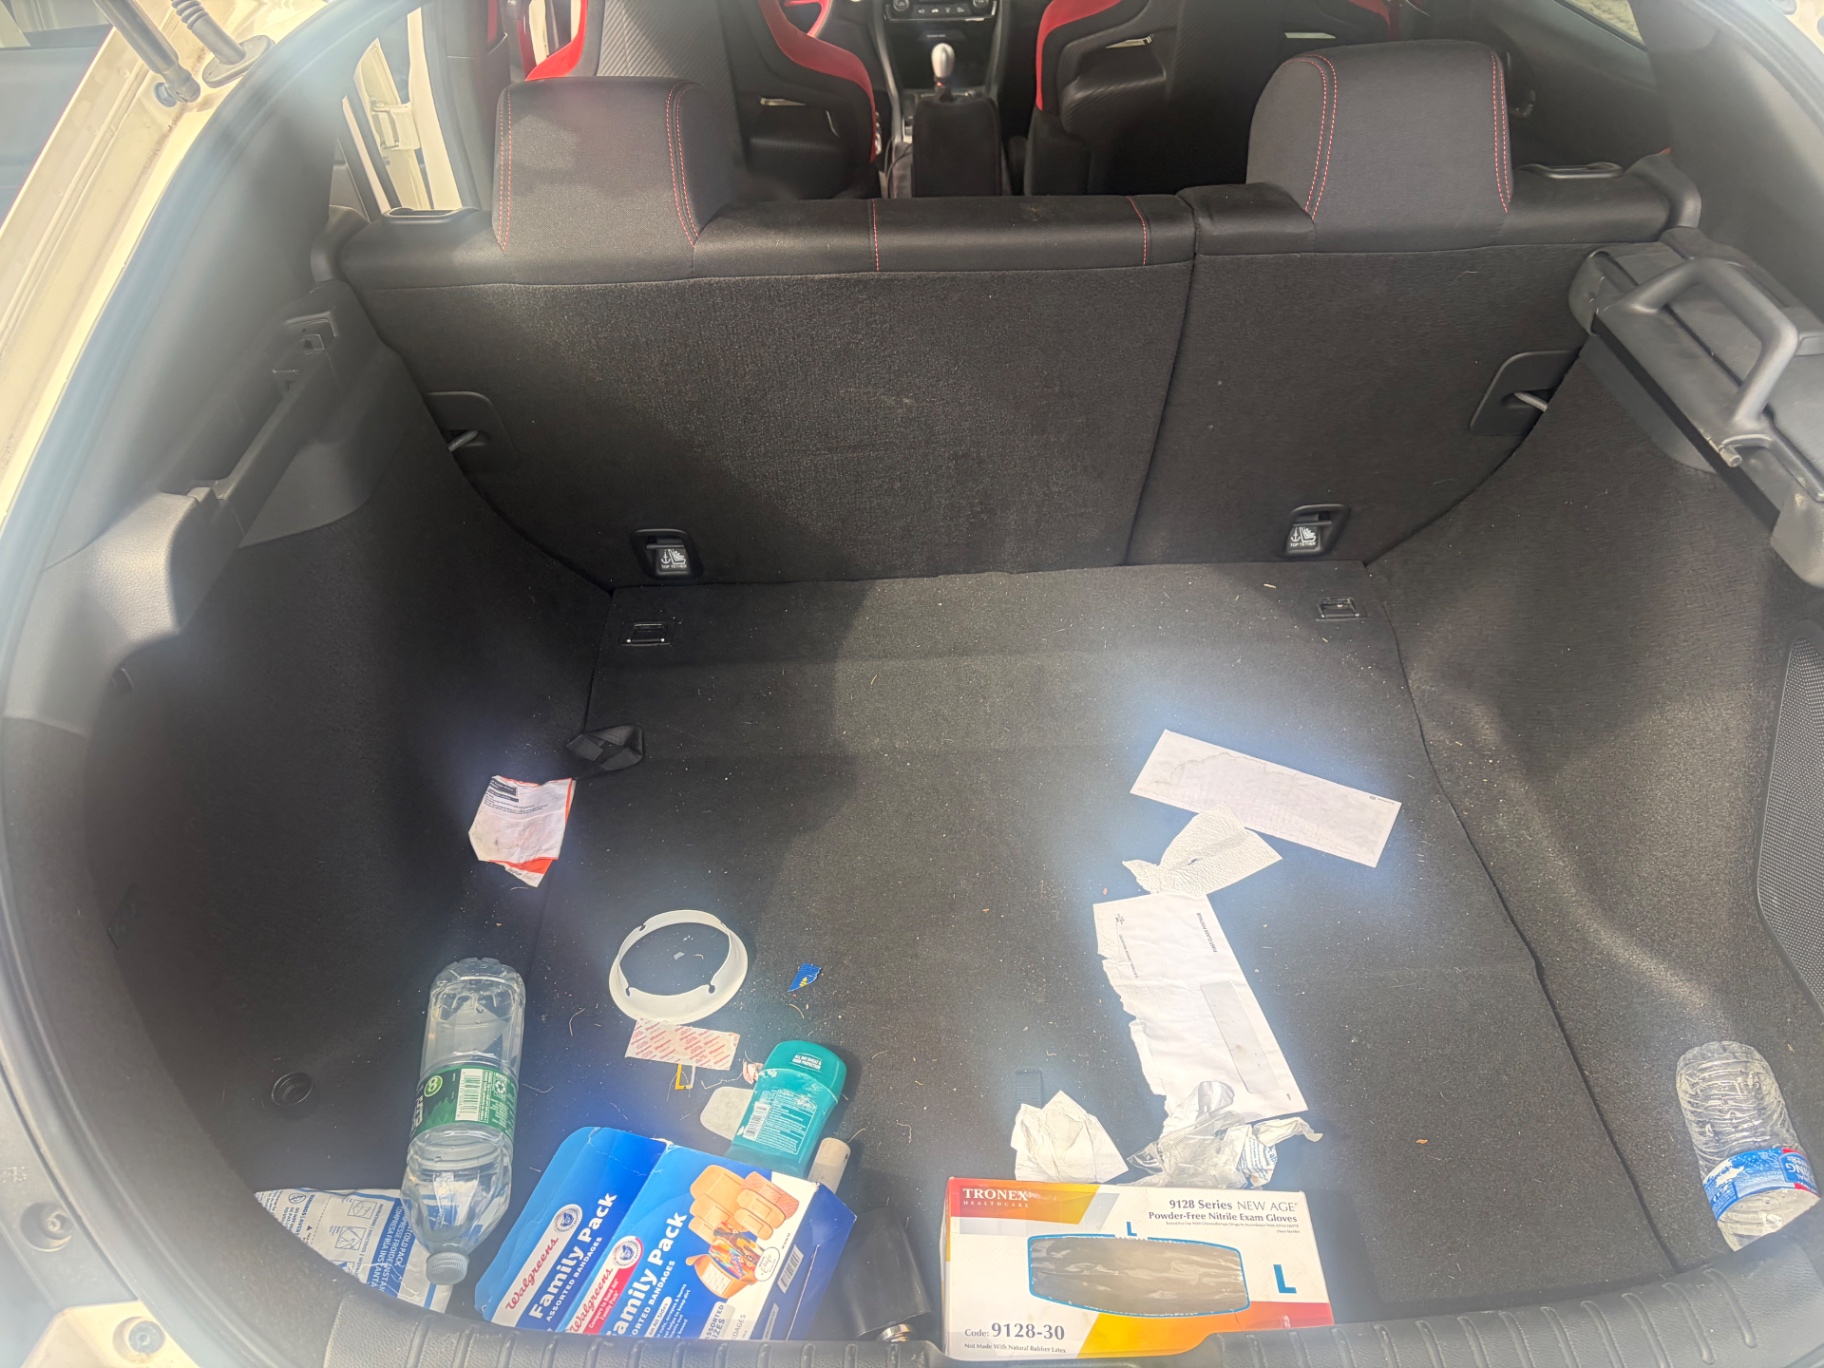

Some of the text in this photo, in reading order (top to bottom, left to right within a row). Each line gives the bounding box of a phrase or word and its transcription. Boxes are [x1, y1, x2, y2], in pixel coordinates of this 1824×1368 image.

[962, 1188, 1029, 1202] TRONEX
[1169, 1200, 1195, 1209] 9128
[1198, 1200, 1233, 1210] Series
[1237, 1200, 1265, 1211] NEW
[386, 1206, 402, 1235] COMPRESA
[1126, 1222, 1137, 1237] L
[1148, 1212, 1297, 1223] Powder-Free Nitrile Exam Gloves
[387, 1240, 400, 1263] FROIDE
[401, 1232, 412, 1249] COLD
[647, 1212, 687, 1266] Pack
[395, 1248, 406, 1267] PACK
[529, 1246, 585, 1318] Family
[577, 1192, 617, 1242] Pack
[505, 1238, 559, 1310] Walgreens
[546, 1237, 602, 1322] ASSORTED BANDAGES
[1273, 1264, 1297, 1294] L
[570, 1268, 613, 1332] Walgreens
[632, 1306, 652, 1336] ORTED
[648, 1260, 676, 1305] BANDAGES
[649, 1328, 655, 1336] on
[659, 1302, 668, 1318] Sides
[711, 1318, 725, 1339] IZES
[965, 1322, 1065, 1340] Code: 9128-30
